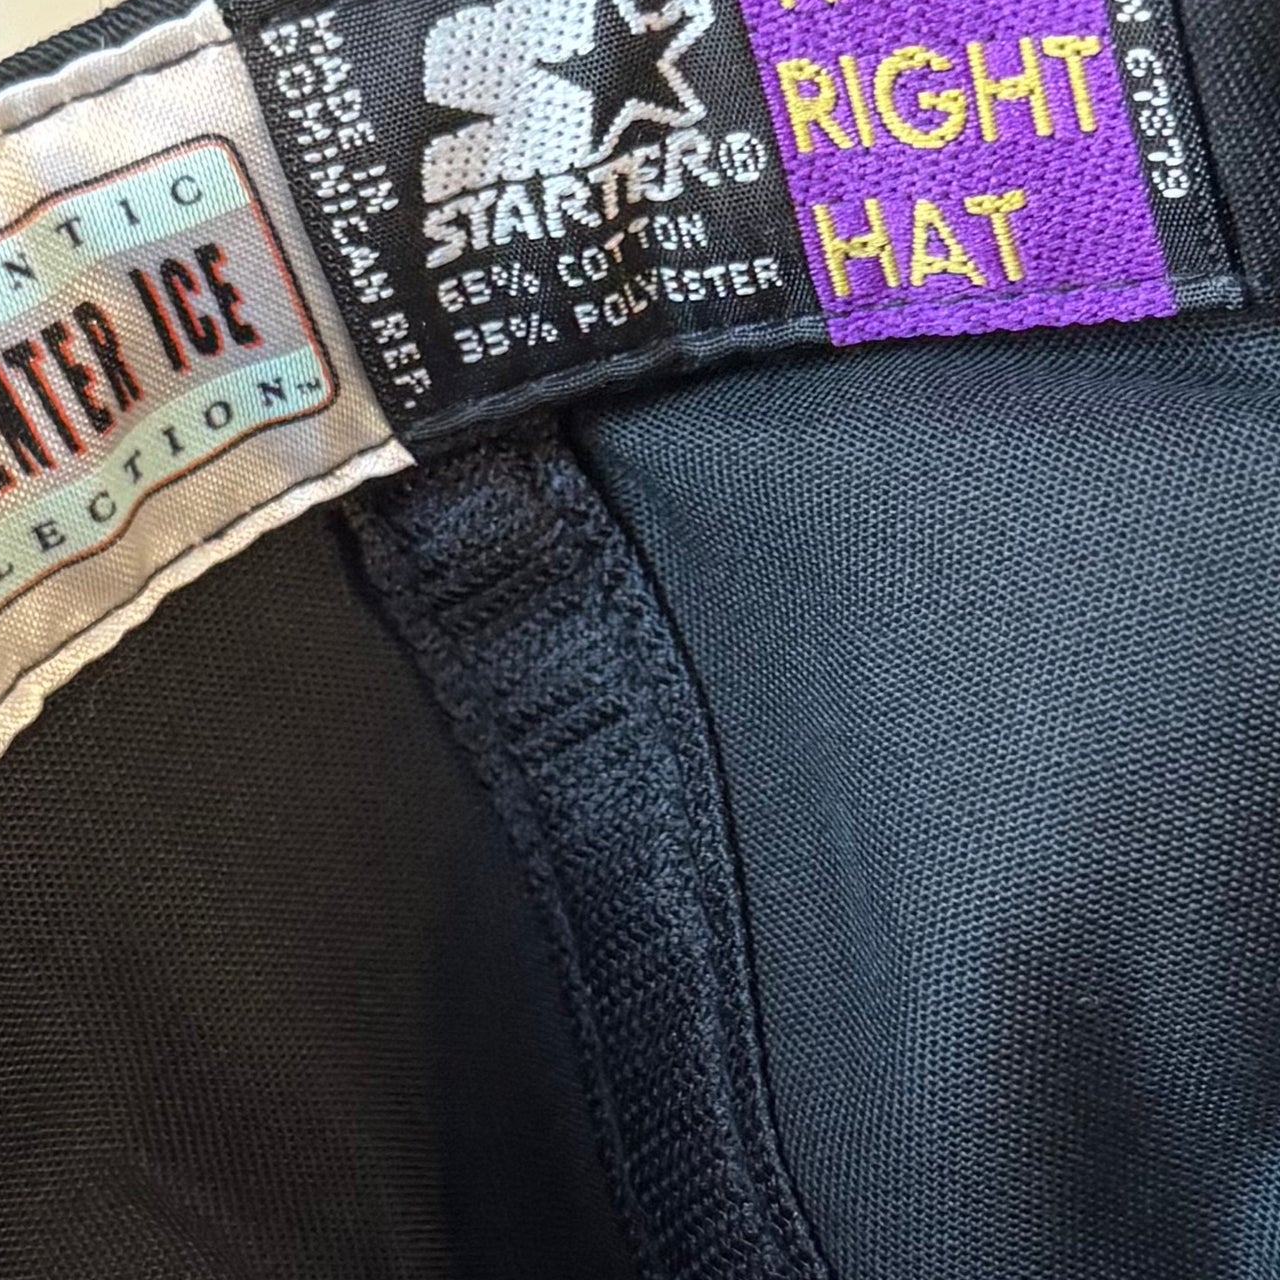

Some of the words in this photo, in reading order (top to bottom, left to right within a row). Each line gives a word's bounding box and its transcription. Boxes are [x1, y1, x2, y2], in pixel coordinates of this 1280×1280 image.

[303, 11, 375, 149] MADE
[353, 165, 399, 212] IN
[775, 36, 1100, 153] RIGHT
[261, 16, 394, 303] DOMINICAN
[371, 311, 431, 409] REP.
[437, 265, 540, 312] 65%
[557, 214, 707, 287] COTTON
[812, 189, 1027, 297] HAT
[128, 242, 264, 374] ICE
[452, 317, 559, 363] 35%
[574, 257, 783, 333] POLYESTER
